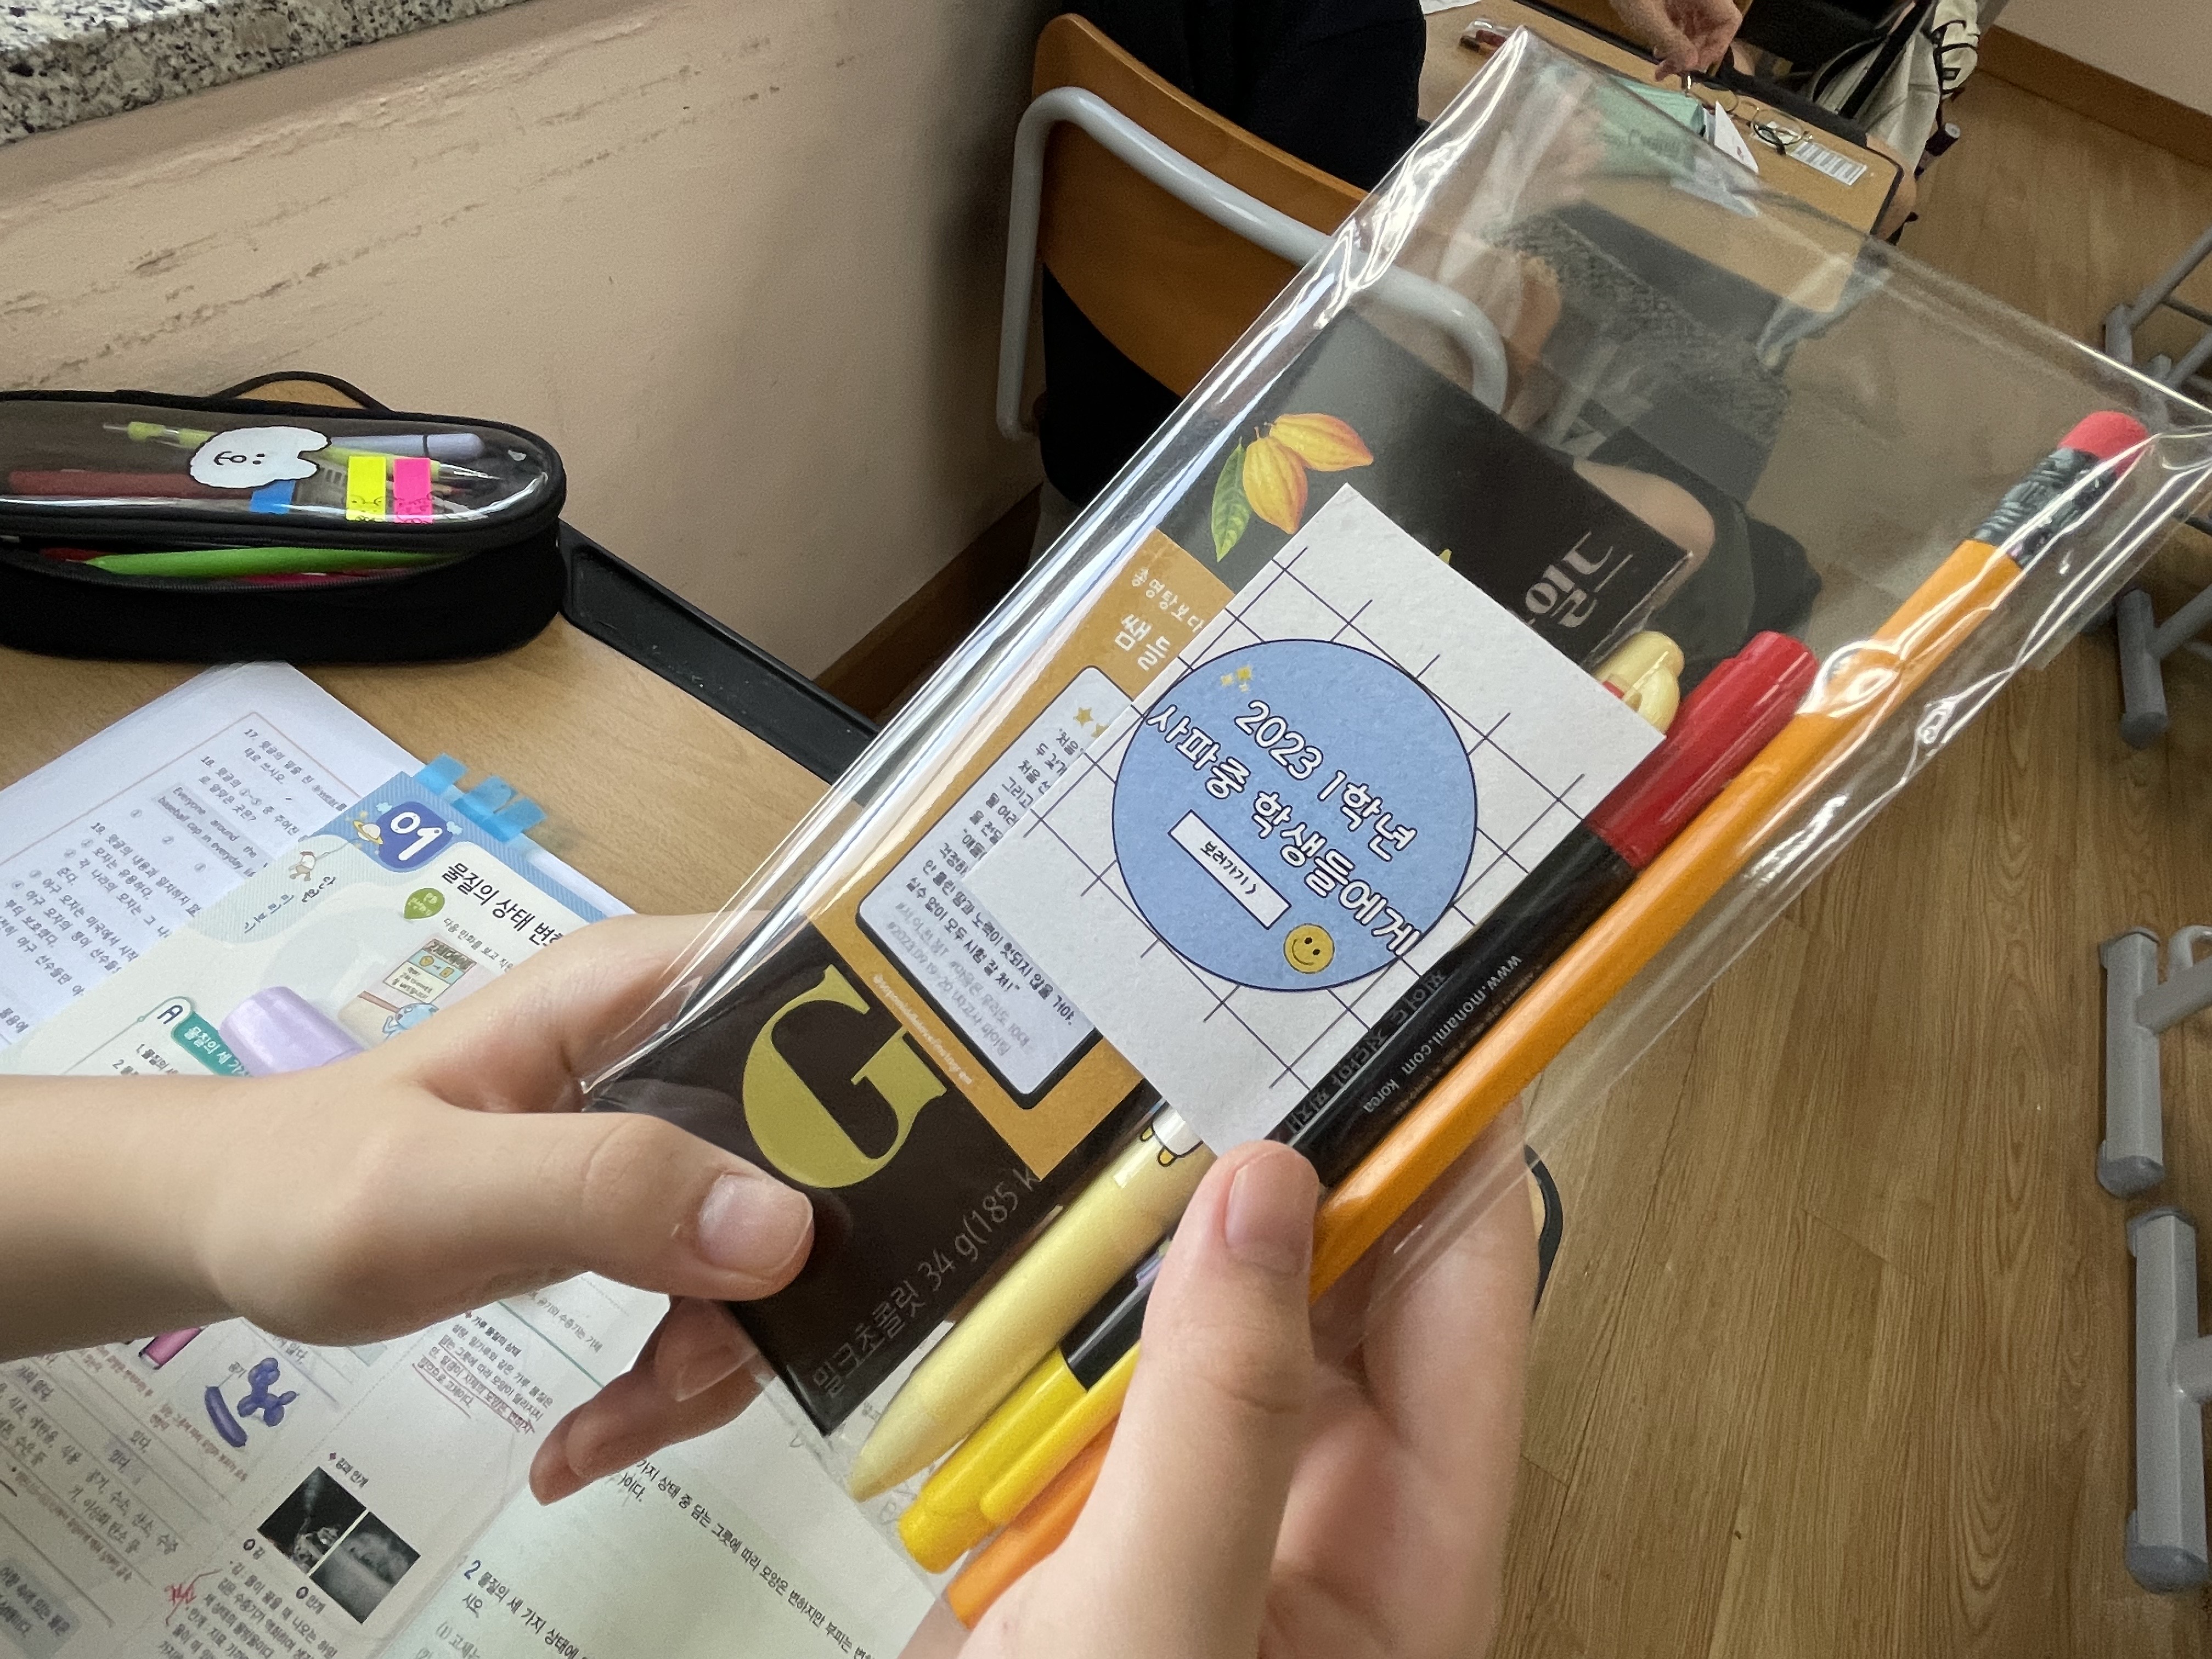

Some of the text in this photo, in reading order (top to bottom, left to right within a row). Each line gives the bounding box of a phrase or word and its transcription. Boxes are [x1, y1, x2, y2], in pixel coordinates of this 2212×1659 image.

[1525, 531, 1633, 628] 일드
[1017, 759, 1040, 783] 처음
[1035, 742, 1049, 756] 두
[1234, 699, 1418, 862] 2023 1학년
[172, 787, 257, 858] Everyone around the
[1001, 776, 1034, 809] 그리고
[93, 847, 117, 869] 모자는
[157, 795, 242, 869] baseball cap in everyday
[391, 812, 442, 861] 01
[1147, 704, 1421, 955] 사파중 학생들에게
[1200, 840, 1249, 886] 보러가기
[86, 916, 120, 946] 미국에서
[91, 868, 118, 893] 나라의
[116, 893, 141, 915] 모자는
[143, 915, 156, 926] 그
[442, 862, 499, 905] 물질의
[492, 899, 535, 932] 상태
[906, 877, 927, 898] 실수
[924, 896, 948, 921] 없이
[944, 917, 967, 940] 모두
[963, 939, 987, 963] 시험
[983, 959, 998, 976] 잘
[443, 918, 460, 933] 다음
[482, 943, 499, 960] 보고
[971, 912, 1003, 946] 노력이
[1000, 942, 1033, 977] 헛되지
[1029, 973, 1053, 1000] 않을
[1052, 996, 1074, 1025] 거야.
[157, 1005, 183, 1024] A
[1401, 956, 1522, 1075] www.monami.com
[743, 964, 947, 1188] G
[1363, 1079, 1399, 1113] korea
[812, 1279, 926, 1398] 밀크초콜릿
[918, 1249, 956, 1291] 34
[463, 1559, 481, 1580] 2
[477, 1571, 510, 1602] 물질의
[506, 1596, 523, 1614] 세
[521, 1607, 546, 1634] 가지
[657, 1476, 681, 1499] 상태
[678, 1493, 692, 1509] 중
[690, 1503, 711, 1528] 담는
[711, 1523, 742, 1554] 그릇에
[740, 1547, 761, 1571] 따라
[759, 1565, 788, 1596] 모양은
[788, 1590, 825, 1627] 변하지만
[825, 1622, 852, 1653] 부피는
